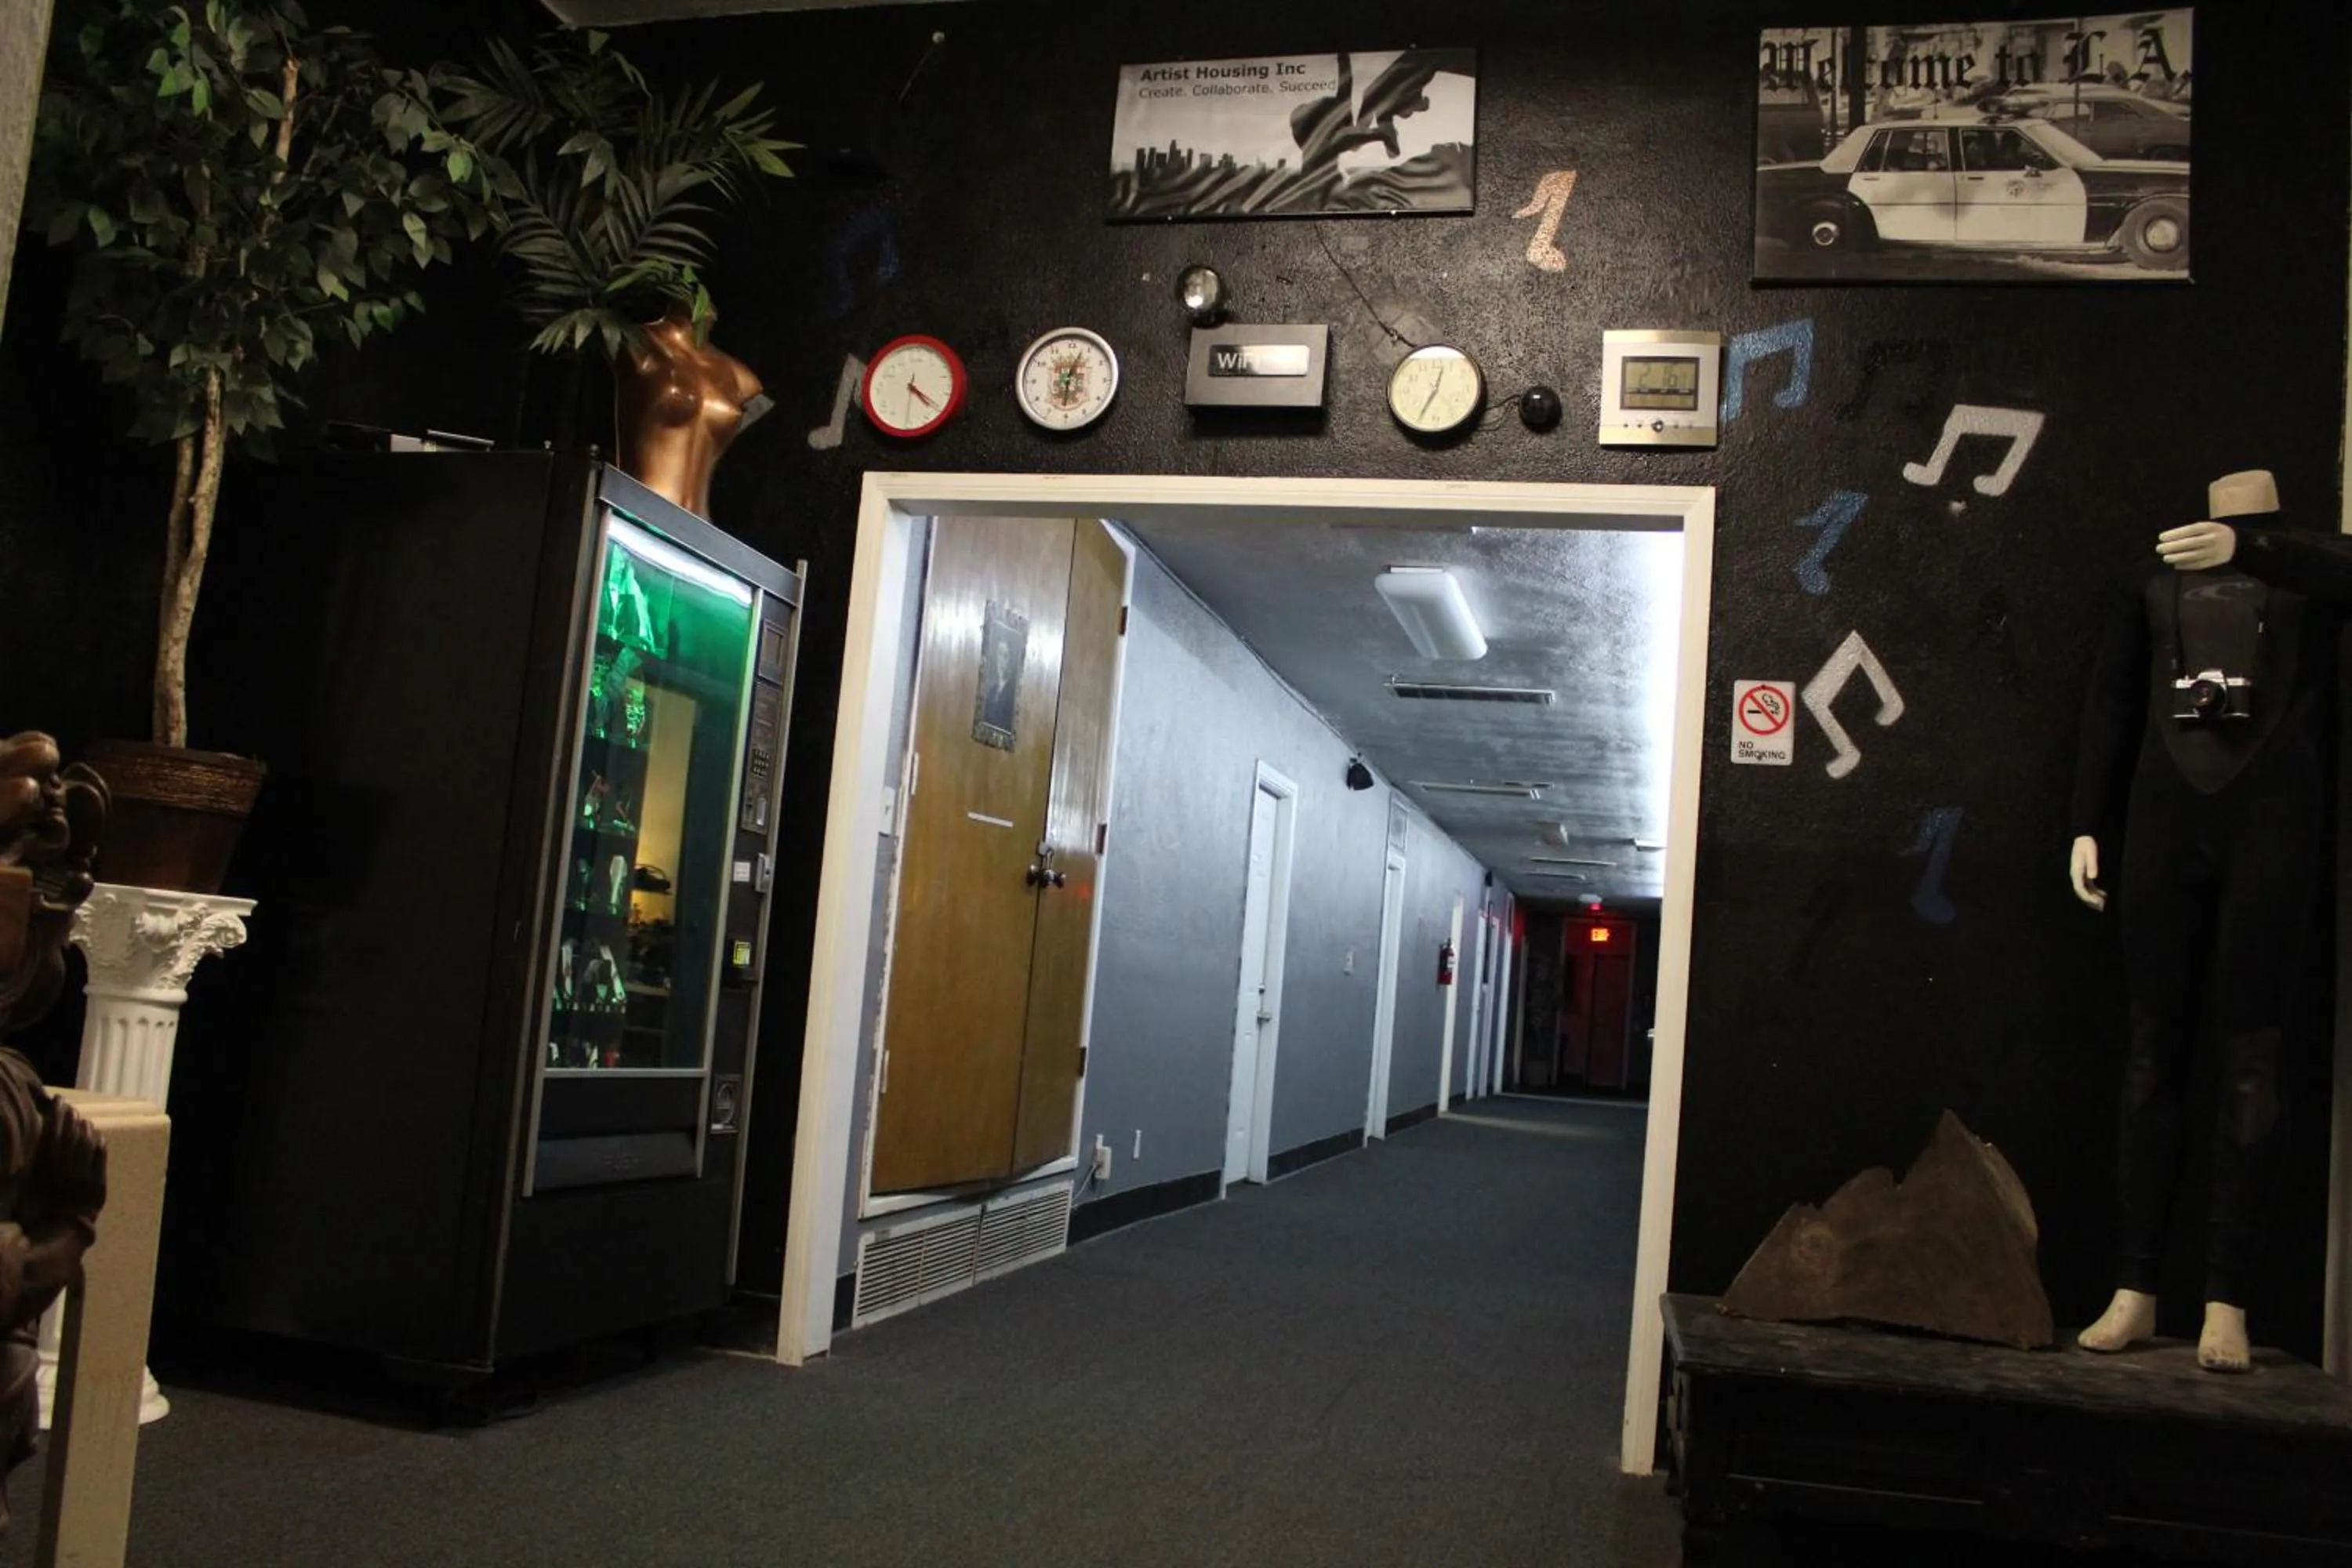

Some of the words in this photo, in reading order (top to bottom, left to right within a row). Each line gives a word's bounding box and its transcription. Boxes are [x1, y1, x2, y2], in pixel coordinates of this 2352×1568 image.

[1141, 67, 1189, 82] Artist
[1196, 64, 1269, 79] Housing
[1276, 62, 1306, 76] Inc
[1994, 44, 2041, 86] to
[1738, 741, 1754, 750] NO
[1738, 749, 1786, 760] SMOKING
